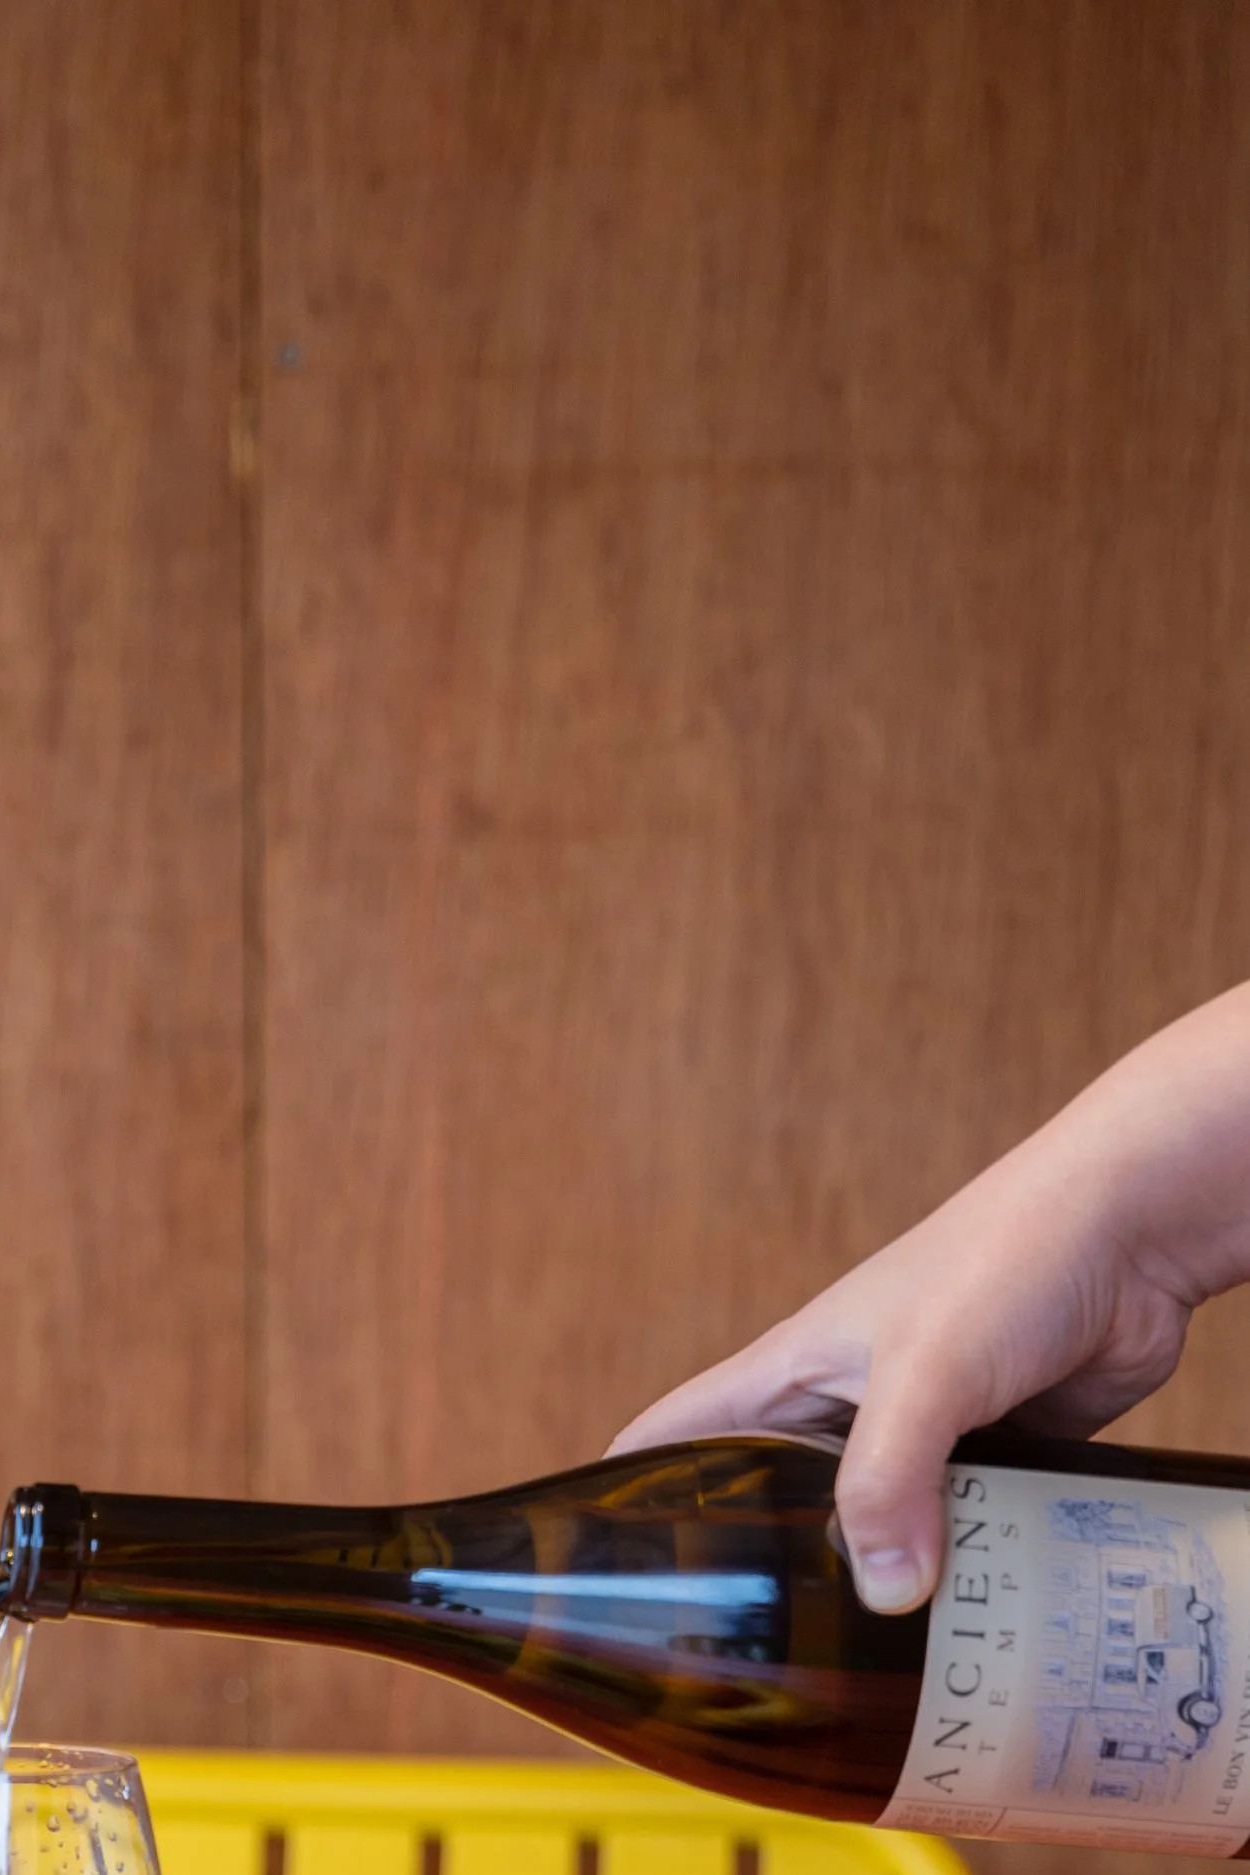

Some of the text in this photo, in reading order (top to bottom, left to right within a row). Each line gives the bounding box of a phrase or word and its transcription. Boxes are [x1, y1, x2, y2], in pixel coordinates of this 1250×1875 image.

[923, 1475, 990, 1794] ANCIENS
[977, 1521, 1019, 1756] TEMPS
[1212, 1796, 1234, 1816] LE
[1222, 1752, 1245, 1789] BON
